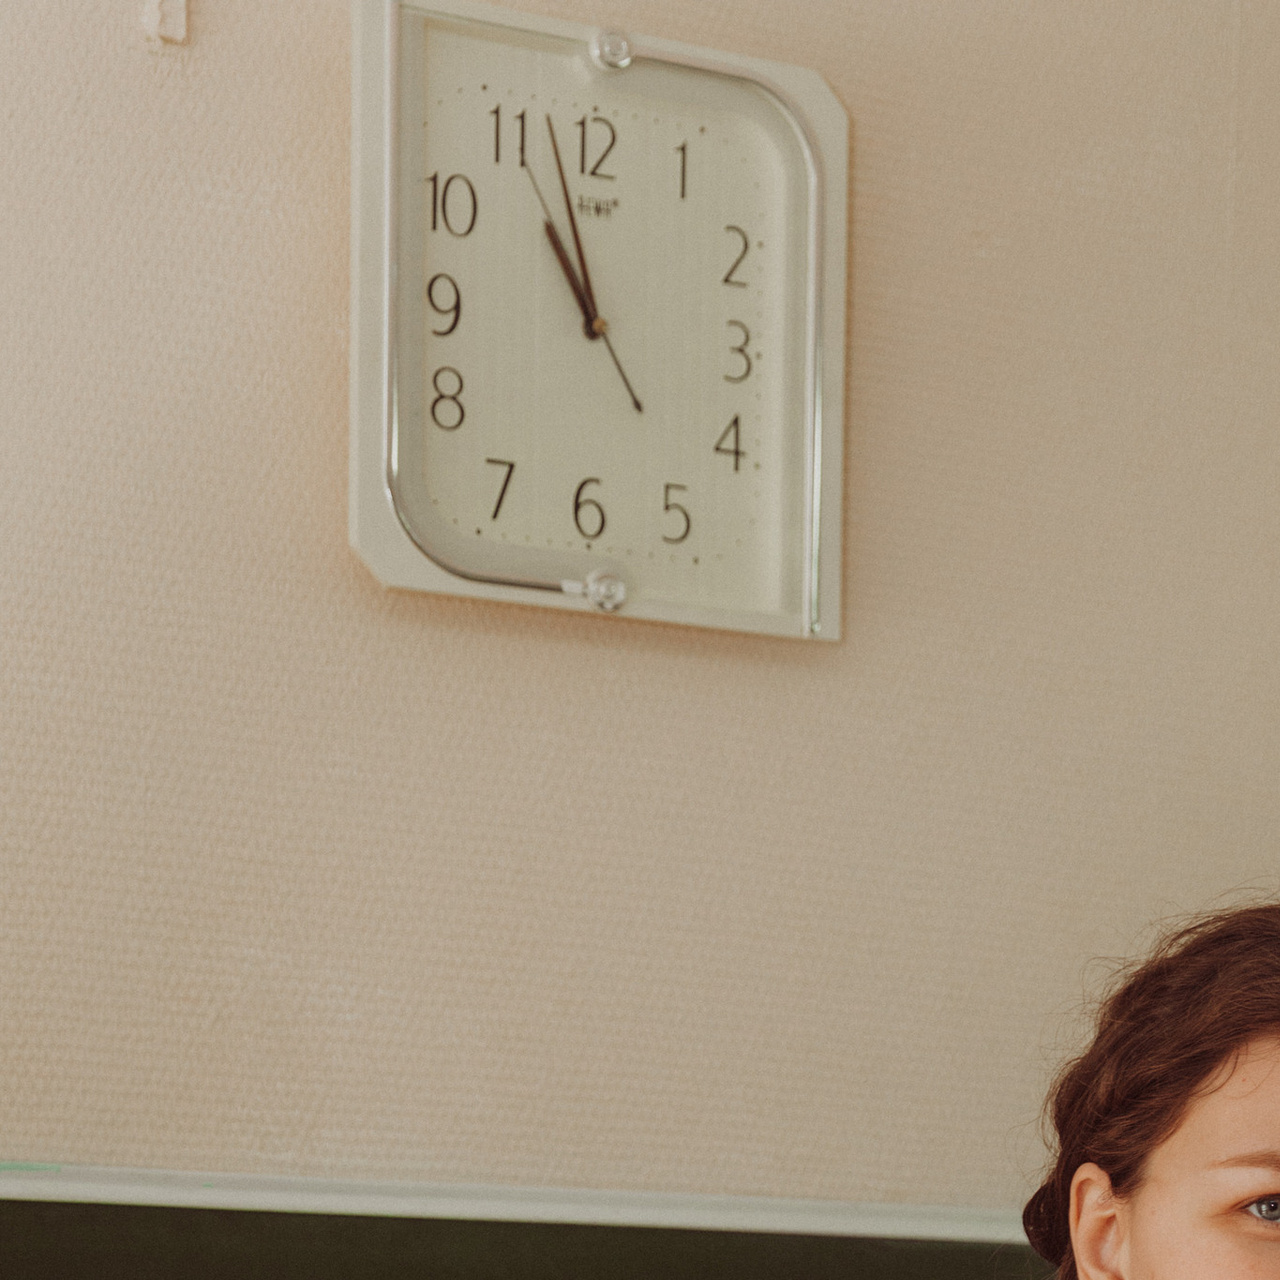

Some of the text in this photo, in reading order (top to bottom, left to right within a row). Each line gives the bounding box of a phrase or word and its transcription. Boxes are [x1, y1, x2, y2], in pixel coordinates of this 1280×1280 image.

[489, 103, 527, 168] 11
[574, 116, 617, 181] 12
[674, 139, 689, 199] 1
[426, 171, 478, 238] 10
[722, 225, 749, 288] 2
[427, 273, 462, 337] 9
[723, 320, 753, 384] 3
[431, 366, 465, 431] 8
[713, 415, 747, 473] 4
[485, 458, 516, 521] 7
[573, 477, 607, 540] 6
[662, 482, 691, 545] 5
